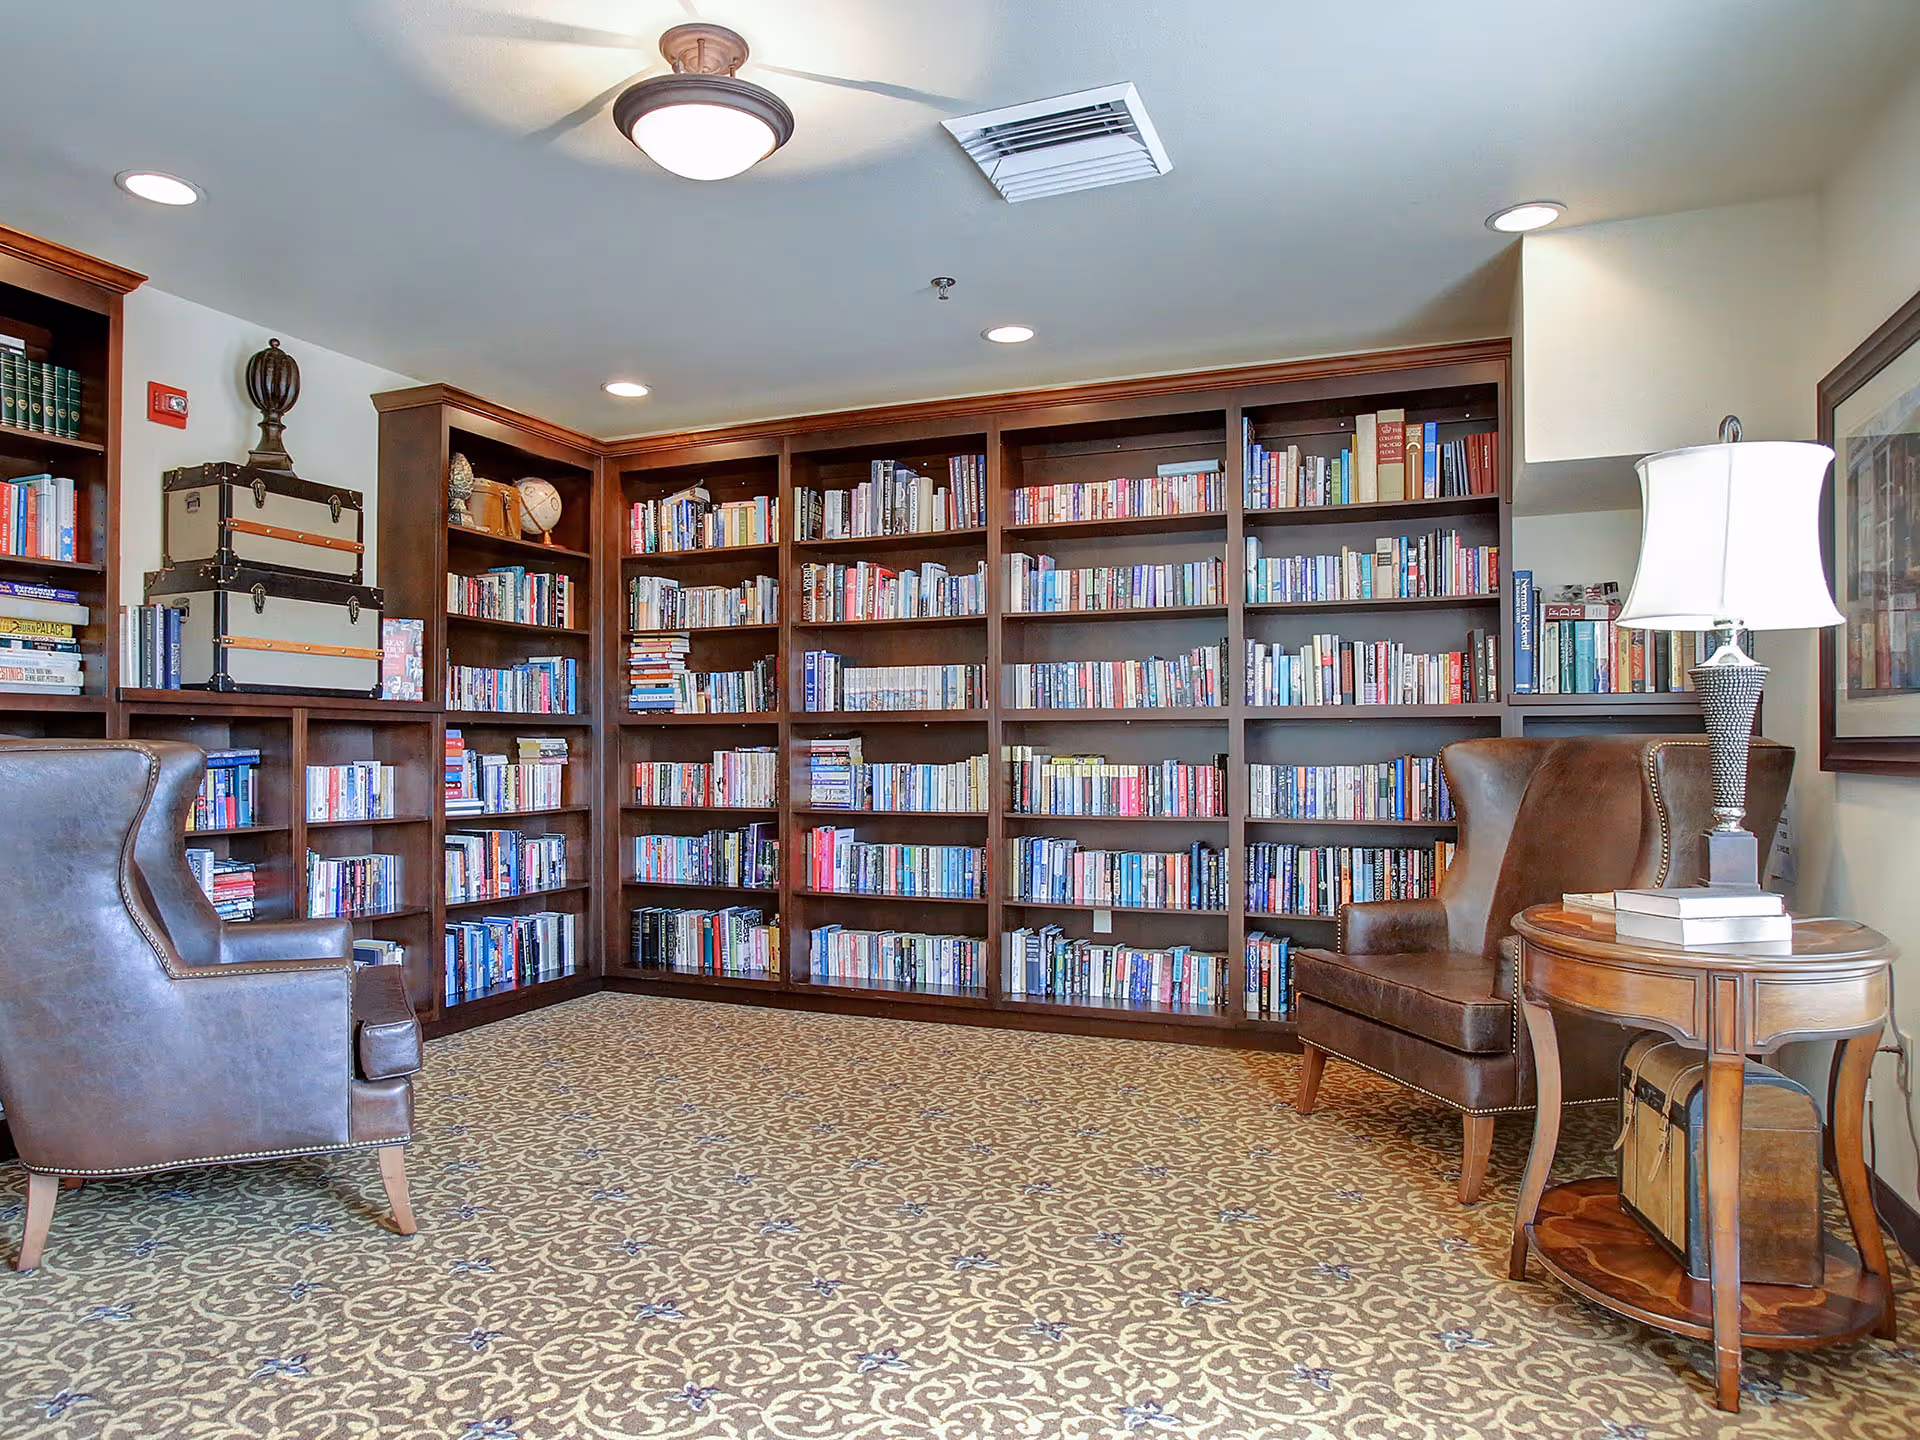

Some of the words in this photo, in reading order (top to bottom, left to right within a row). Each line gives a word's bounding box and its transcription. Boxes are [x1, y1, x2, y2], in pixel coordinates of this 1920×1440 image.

[1520, 578, 1530, 612] Norman
[1548, 607, 1581, 617] FDR
[36, 622, 64, 635] PALACE
[1520, 614, 1531, 650] Rockwell
[171, 643, 180, 675] DANCING
